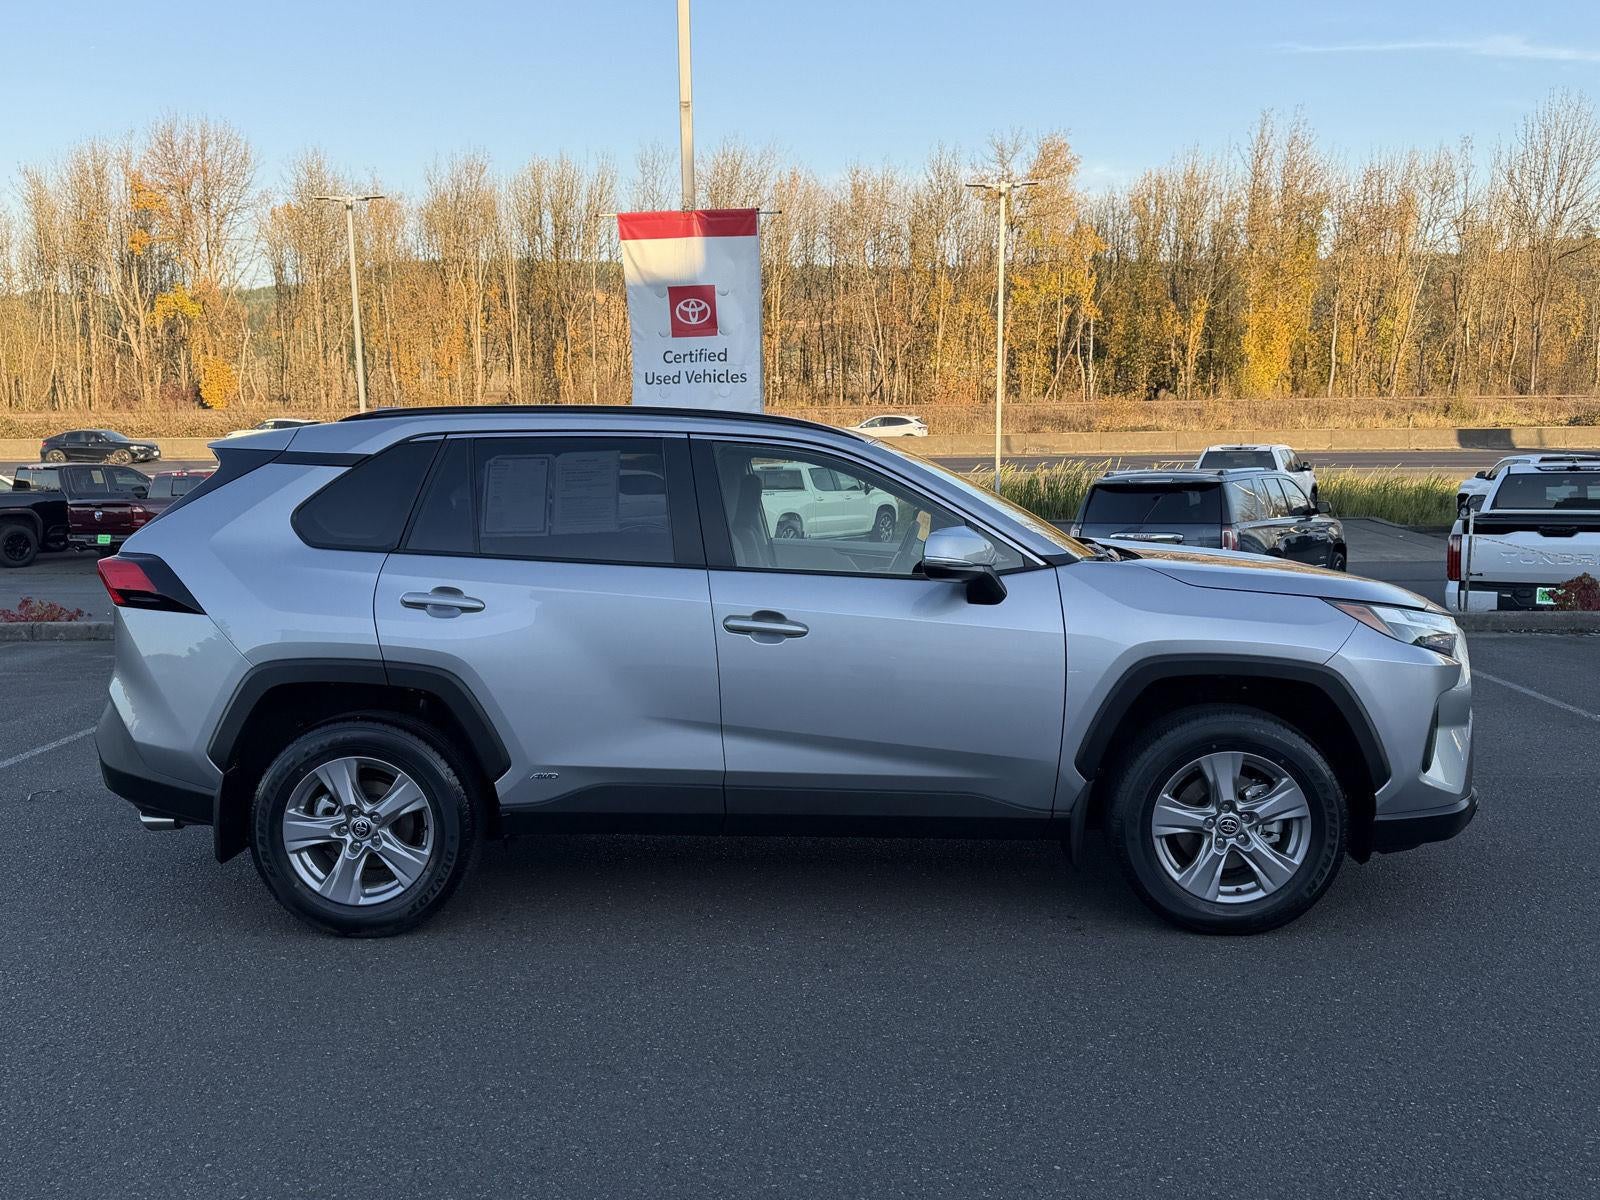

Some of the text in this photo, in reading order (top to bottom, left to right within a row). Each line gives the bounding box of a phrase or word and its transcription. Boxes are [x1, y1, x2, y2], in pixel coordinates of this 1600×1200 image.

[663, 348, 728, 364] Certified
[645, 369, 747, 385] Used Vehicles
[1500, 552, 1600, 565] TUNDR
[529, 772, 559, 780] AWD
